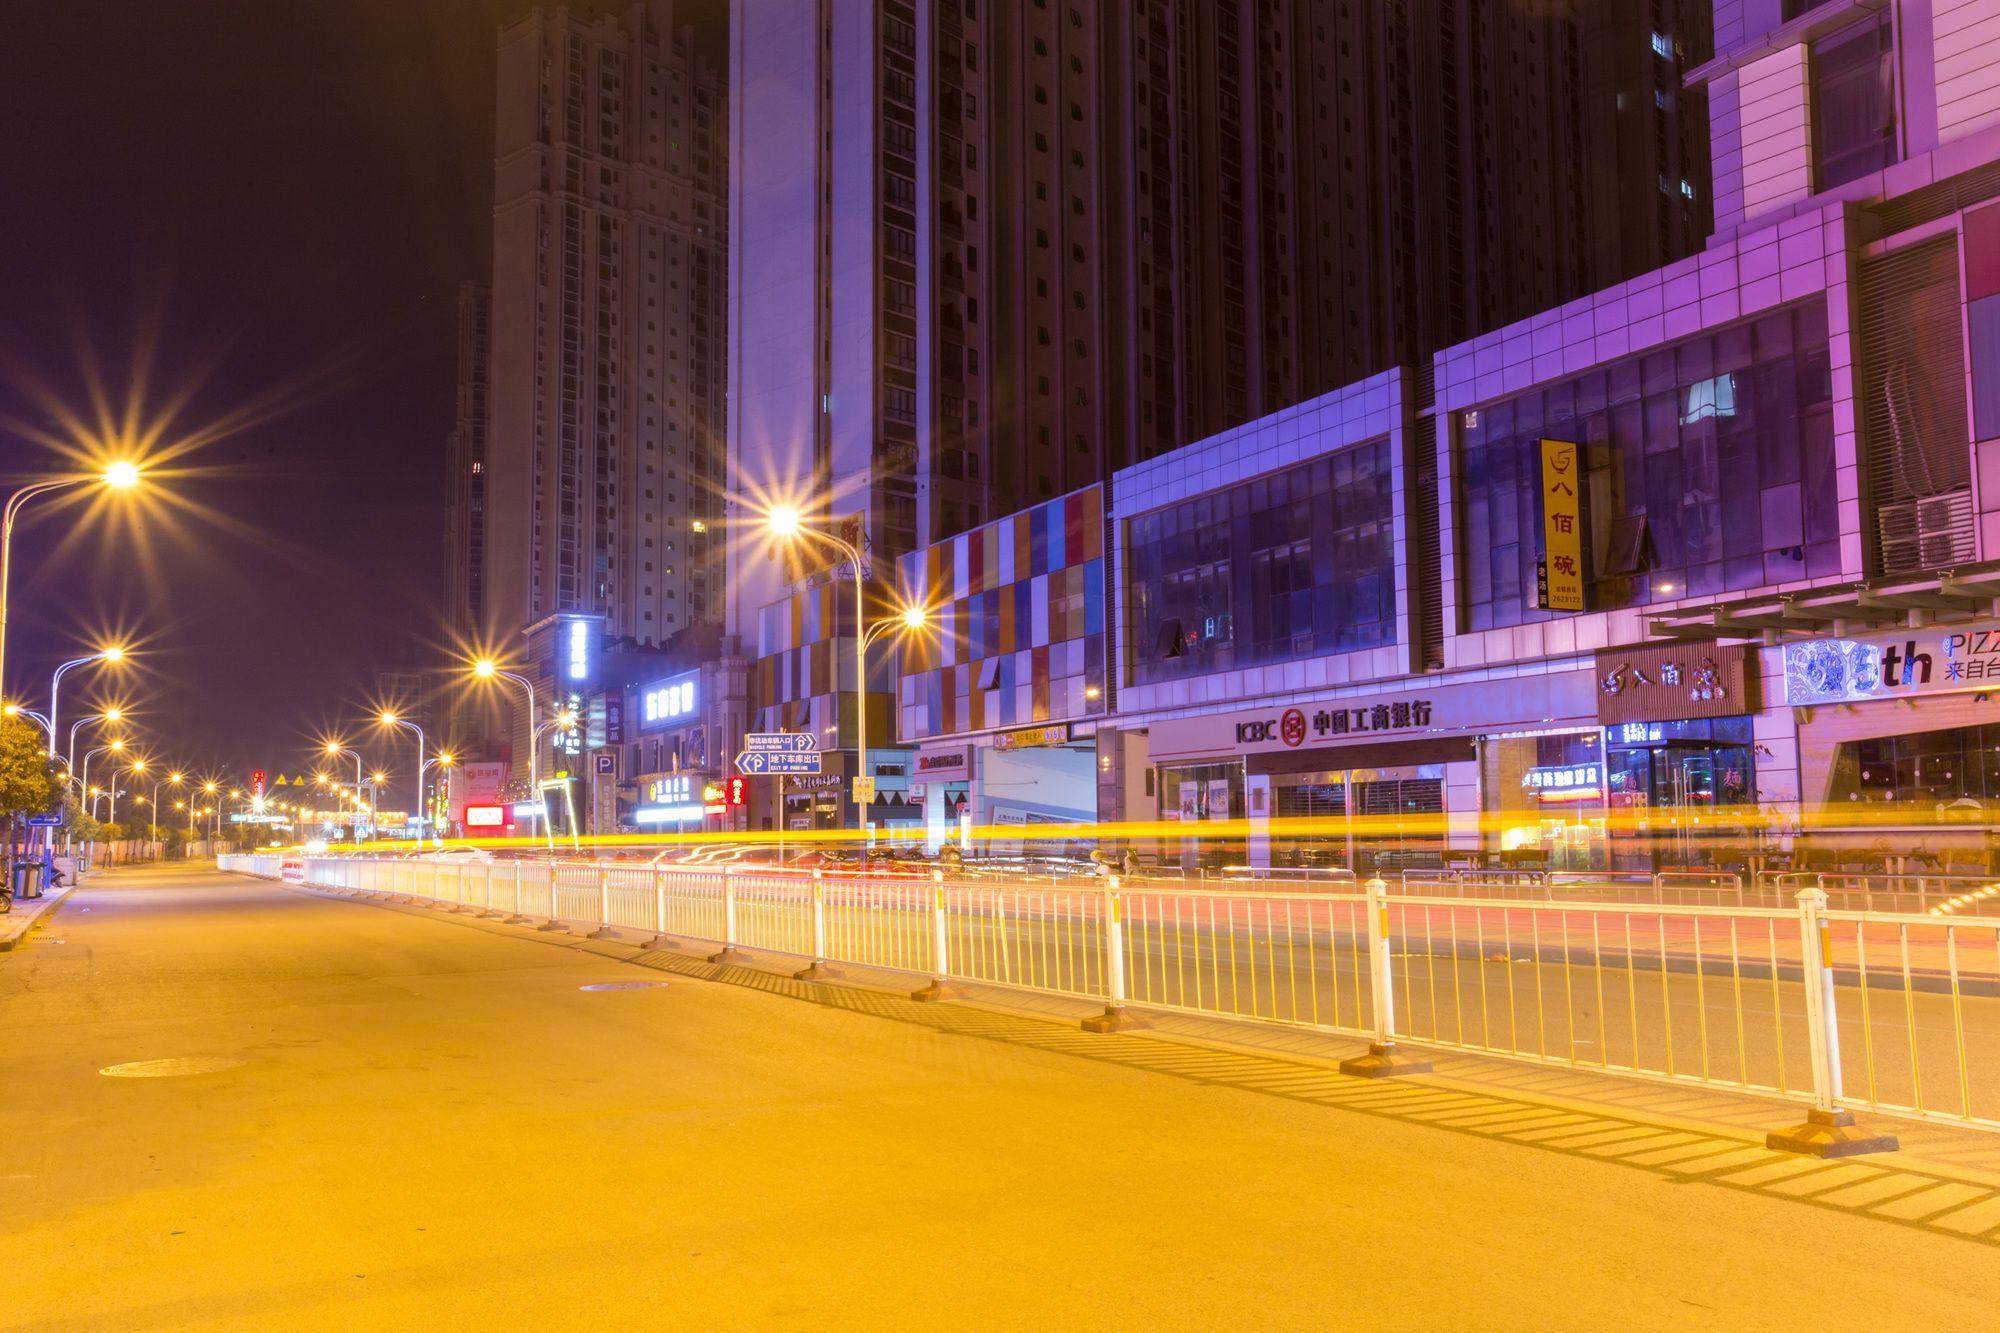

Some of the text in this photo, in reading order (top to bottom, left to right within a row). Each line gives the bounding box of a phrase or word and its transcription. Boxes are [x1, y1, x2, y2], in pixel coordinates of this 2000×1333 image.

[1551, 481, 1577, 577] 八佰碗
[1235, 719, 1277, 744] ICBC
[1312, 700, 1432, 736] 中国工商银行
[770, 754, 819, 763] 地下车库出口
